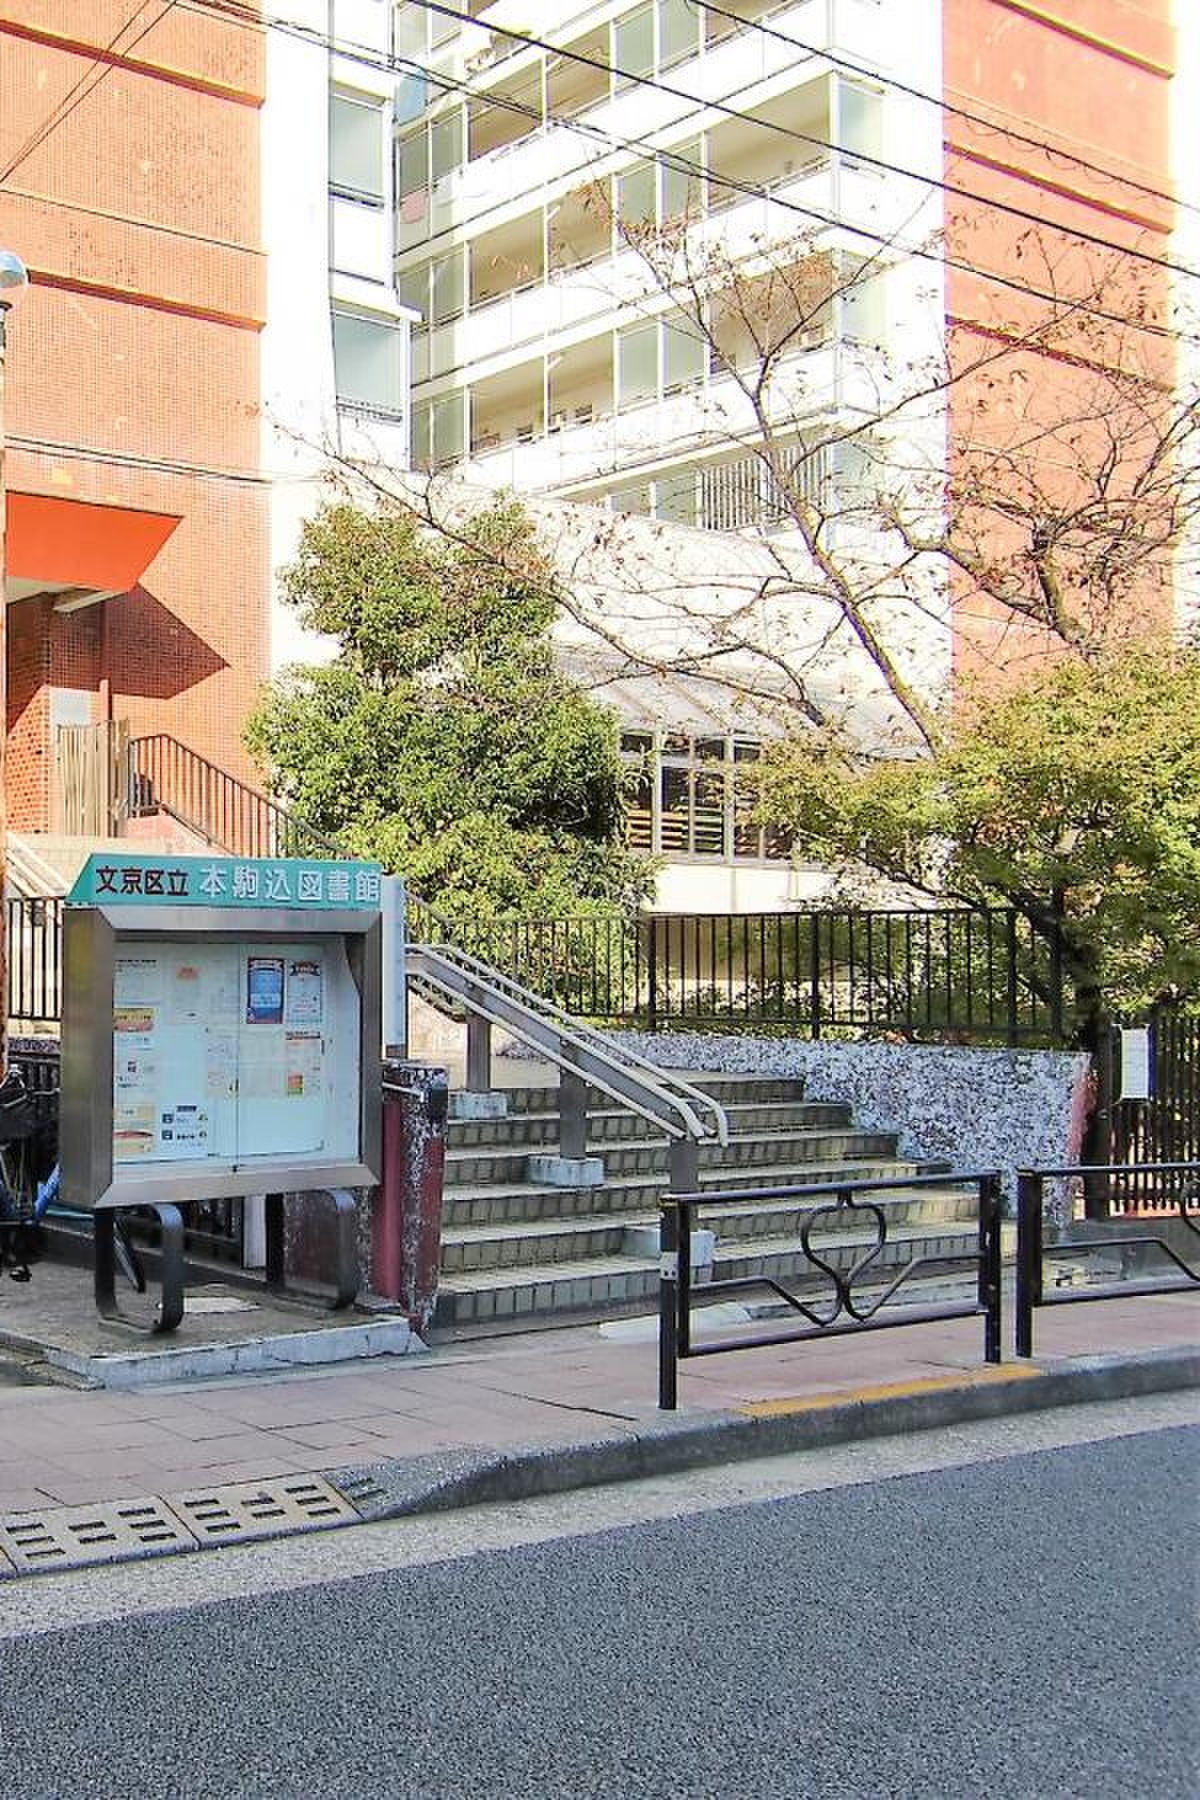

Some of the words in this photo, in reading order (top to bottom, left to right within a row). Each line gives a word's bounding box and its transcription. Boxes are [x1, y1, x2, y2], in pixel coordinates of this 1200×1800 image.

[95, 866, 189, 896] 文京区立
[199, 864, 380, 902] 本駒込図書館
